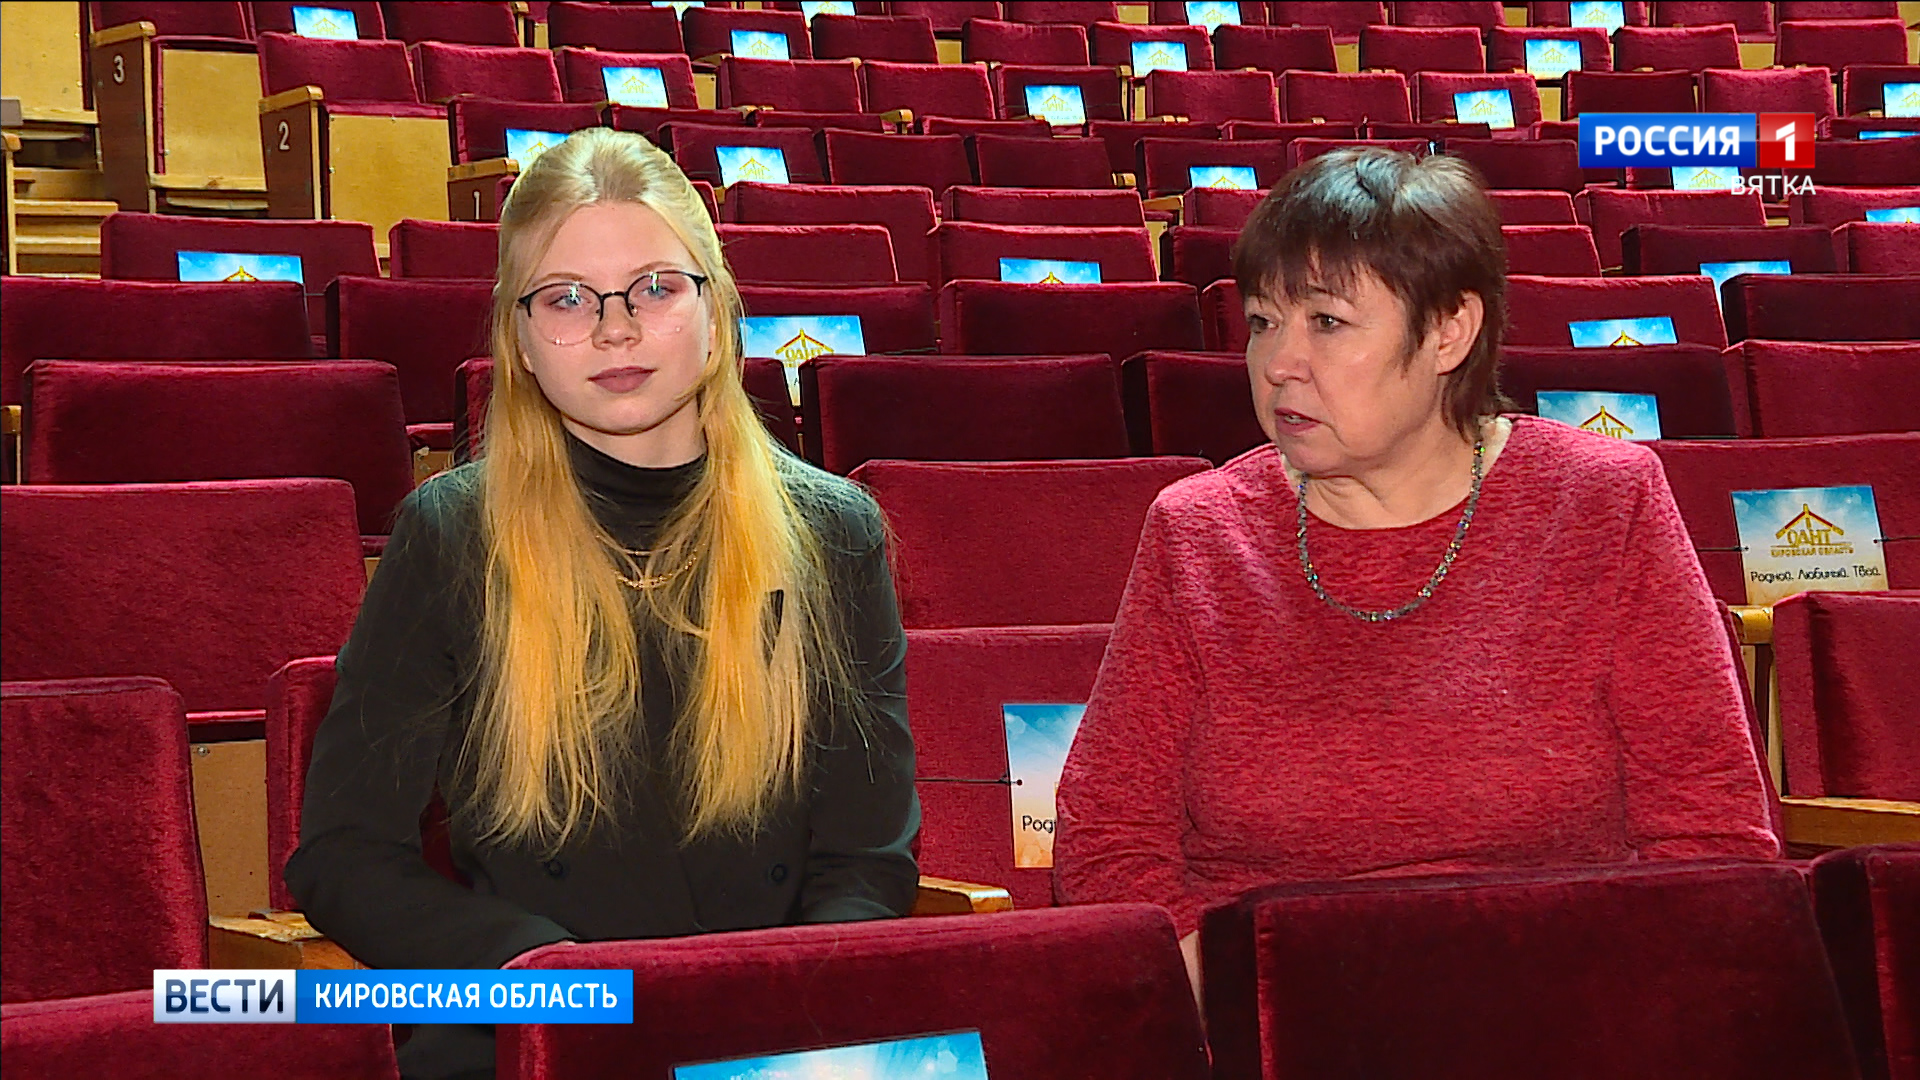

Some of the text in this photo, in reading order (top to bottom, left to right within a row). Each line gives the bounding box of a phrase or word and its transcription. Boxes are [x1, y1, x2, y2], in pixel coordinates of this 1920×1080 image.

[112, 54, 125, 84] 3
[278, 121, 290, 151] 2
[473, 190, 481, 220] 1
[1022, 815, 1056, 833] Род
